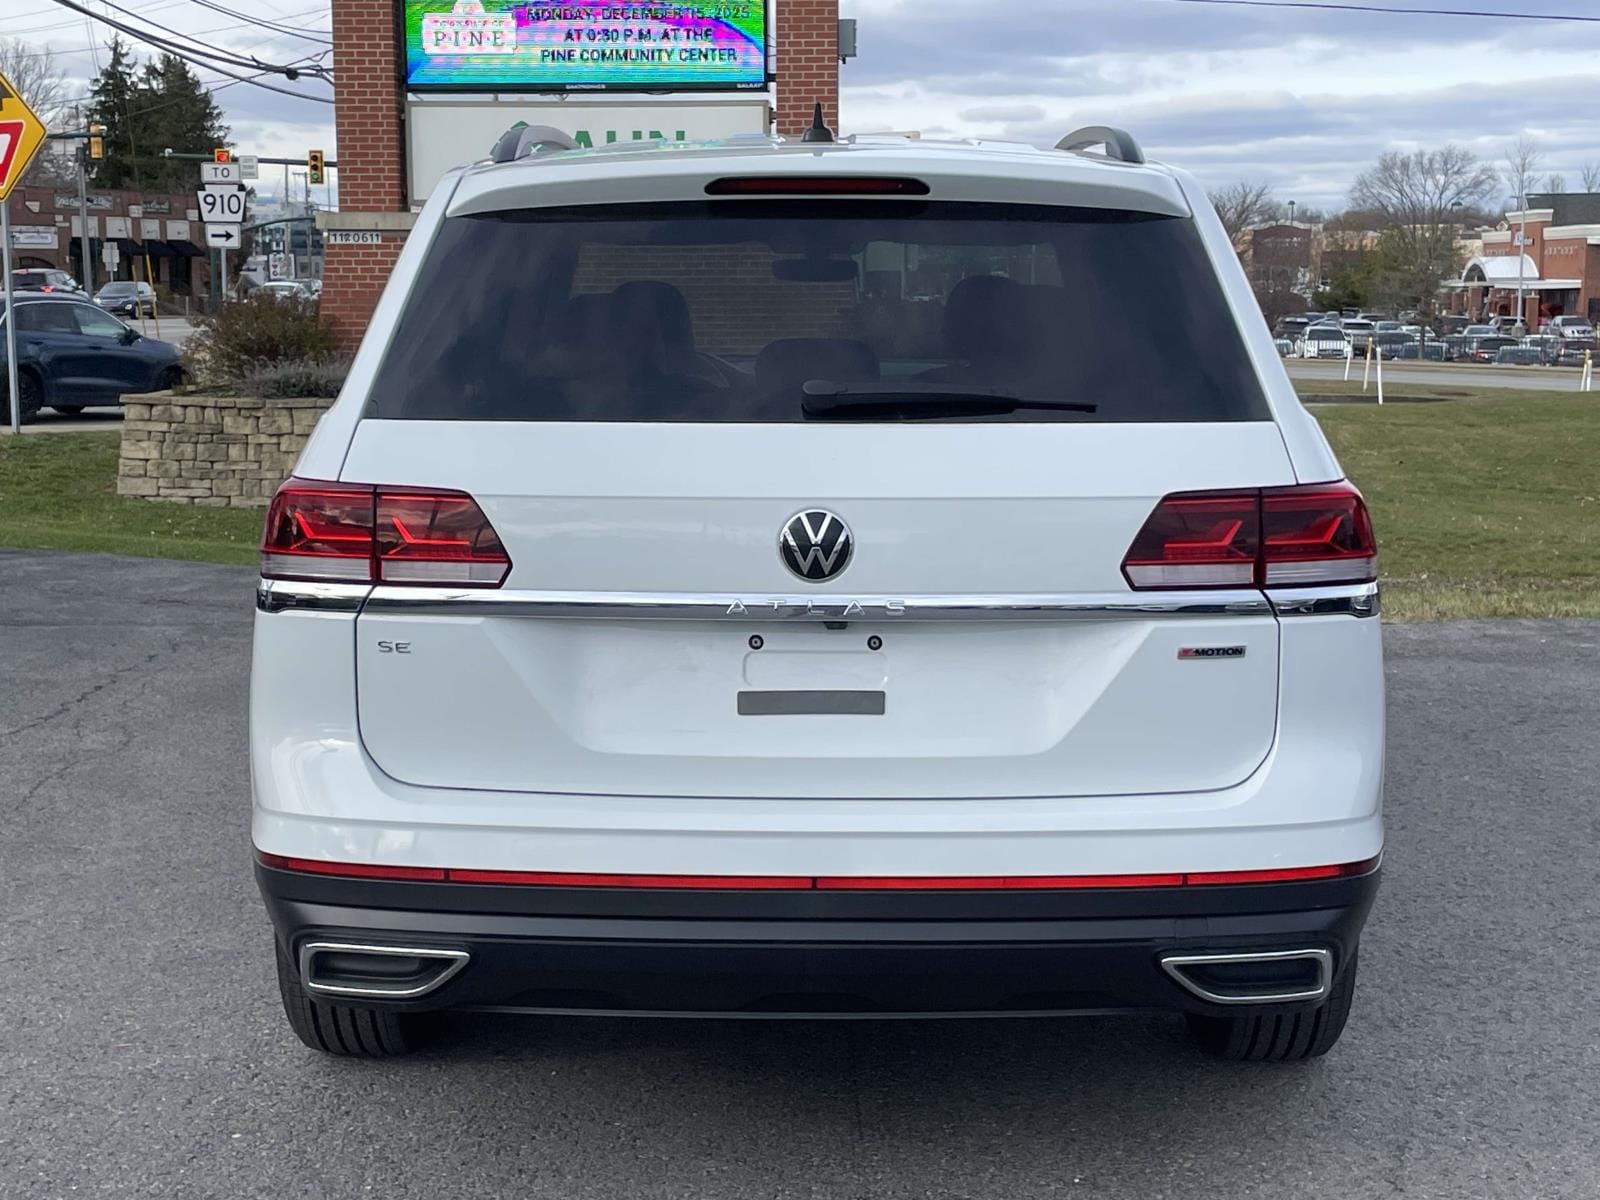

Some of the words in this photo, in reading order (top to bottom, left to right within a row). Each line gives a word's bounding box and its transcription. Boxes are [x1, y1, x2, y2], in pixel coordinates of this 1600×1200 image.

[564, 28, 583, 42] AT
[661, 28, 680, 41] AT
[684, 28, 713, 41] THE
[541, 49, 576, 62] PINE
[580, 49, 673, 62] COMMUNITY
[680, 48, 737, 62] CENTER
[212, 167, 230, 178] TO
[203, 193, 241, 214] 910
[726, 599, 906, 616] ATLAS
[377, 640, 411, 654] SE
